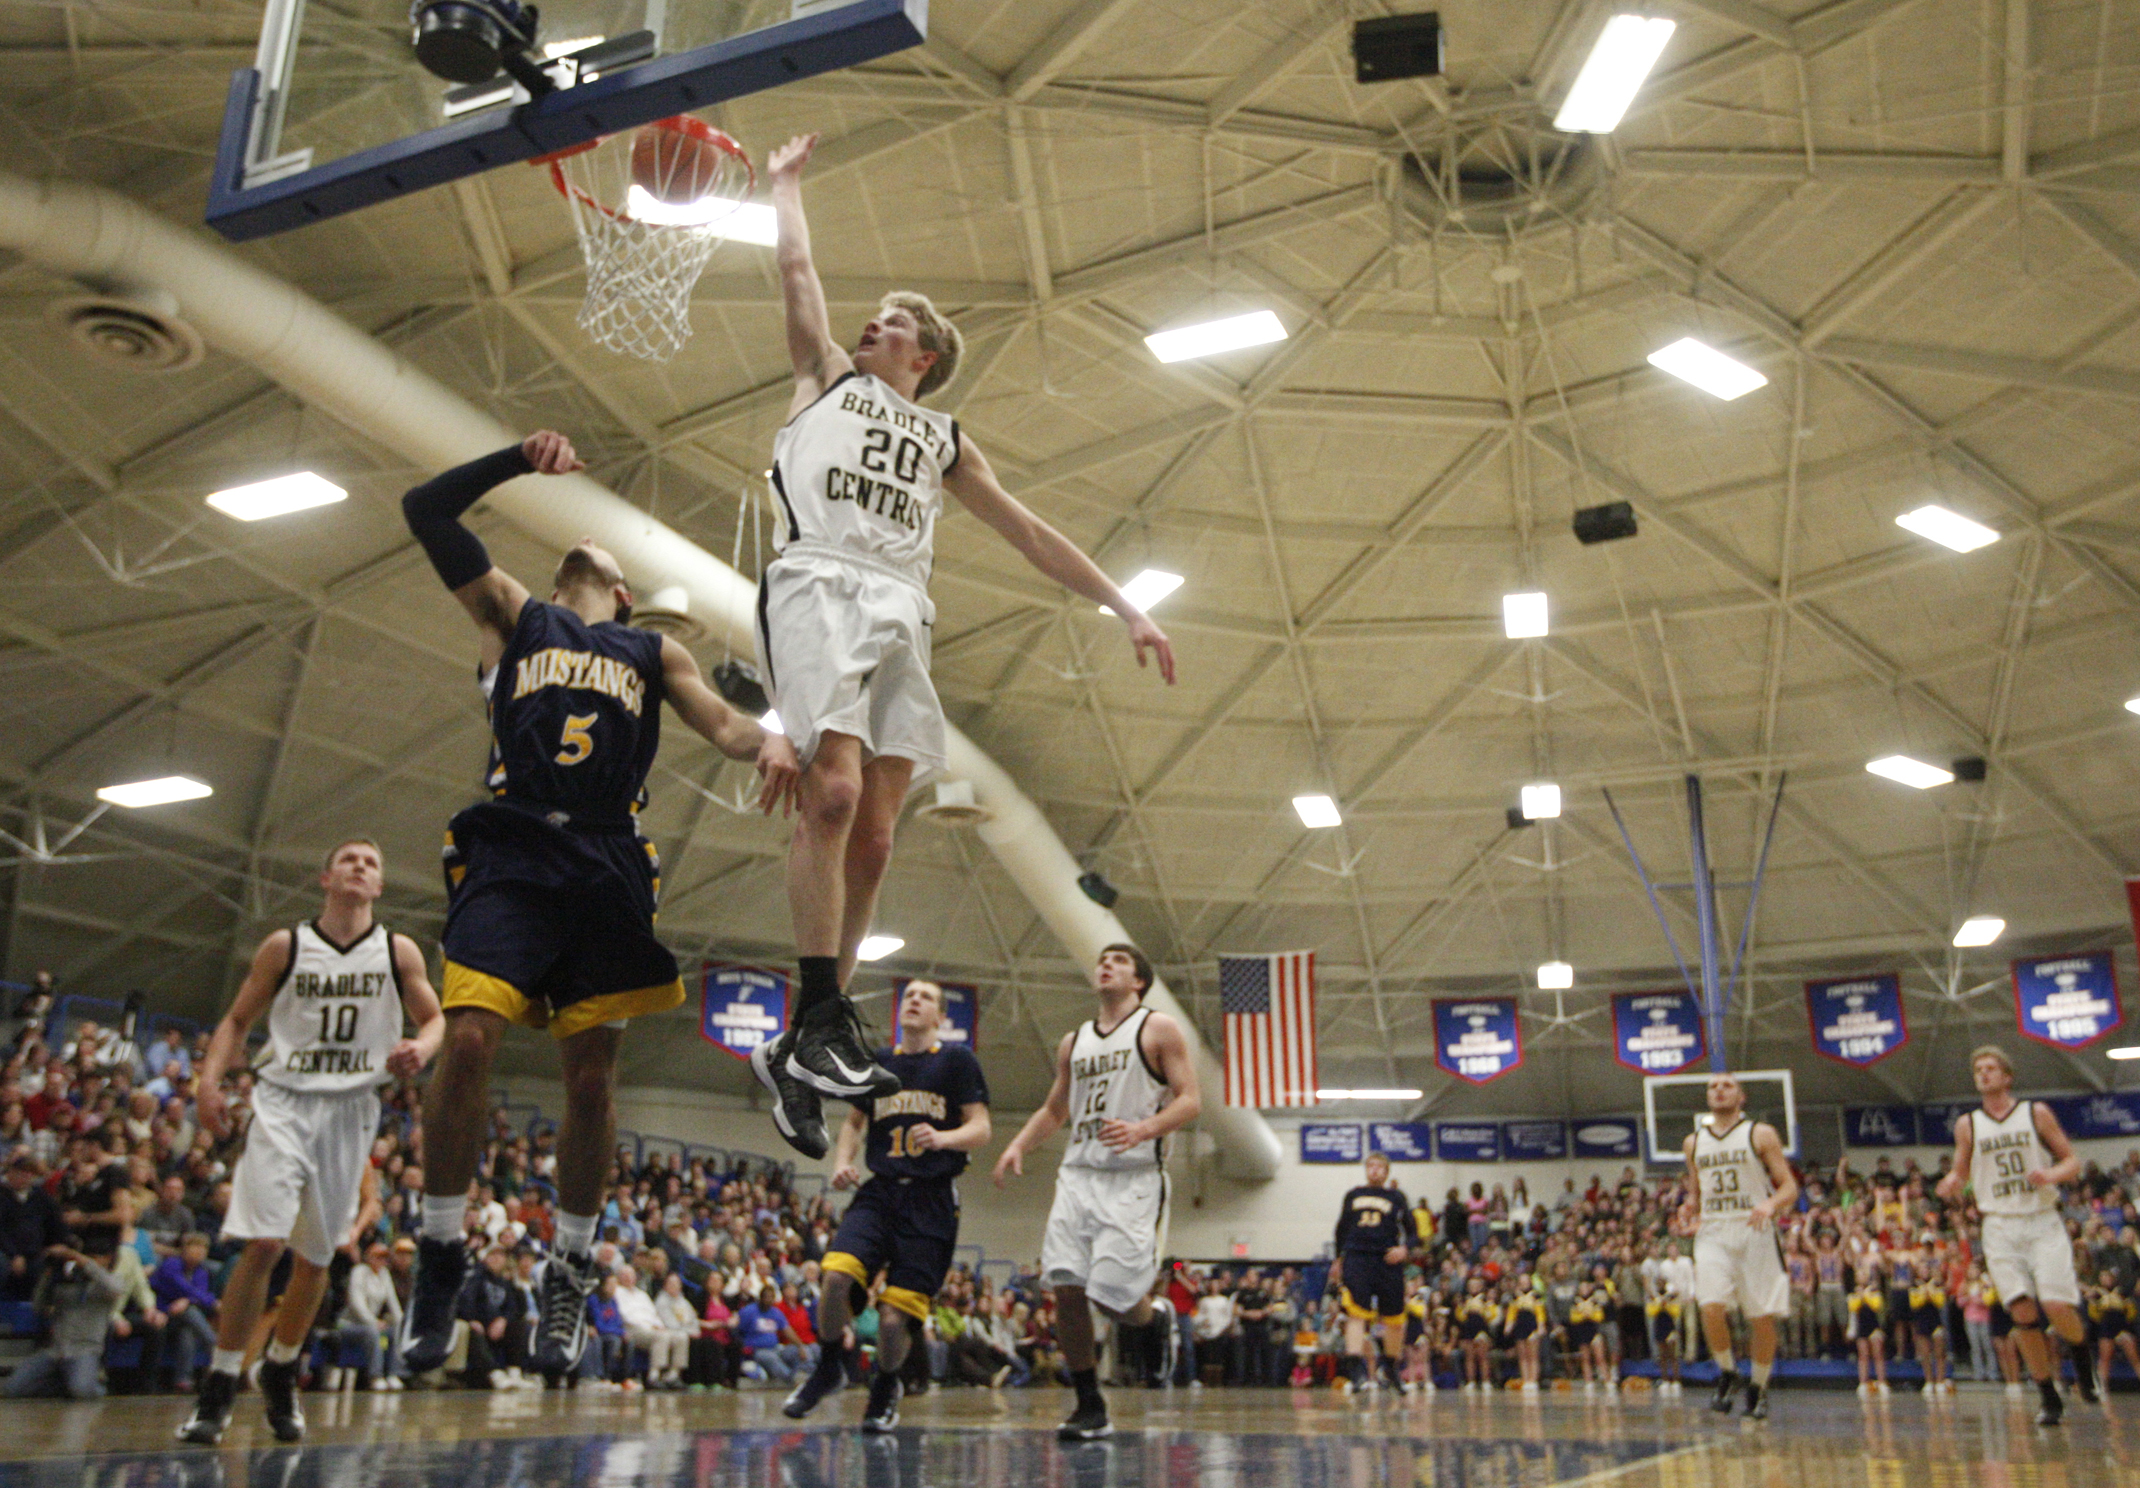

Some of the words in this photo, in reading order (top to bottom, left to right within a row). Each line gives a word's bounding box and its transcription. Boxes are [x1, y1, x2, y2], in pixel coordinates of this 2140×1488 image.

[861, 428, 923, 484] 20
[826, 467, 922, 531] CENTRA
[512, 647, 645, 718] MUSTANGS
[553, 711, 599, 767] 5
[295, 972, 387, 998] BRADLEY
[319, 1004, 358, 1042] 10
[286, 1048, 375, 1074] CENTRAL
[1073, 1048, 1132, 1080] BRADLEY
[874, 1090, 946, 1122] MUSTANGS
[1084, 1079, 1109, 1115] 12
[1979, 1130, 2031, 1155] BRADLEY
[1698, 1149, 1747, 1169] BRADLEY
[1995, 1150, 2025, 1177] 50
[1711, 1167, 1739, 1194] 33
